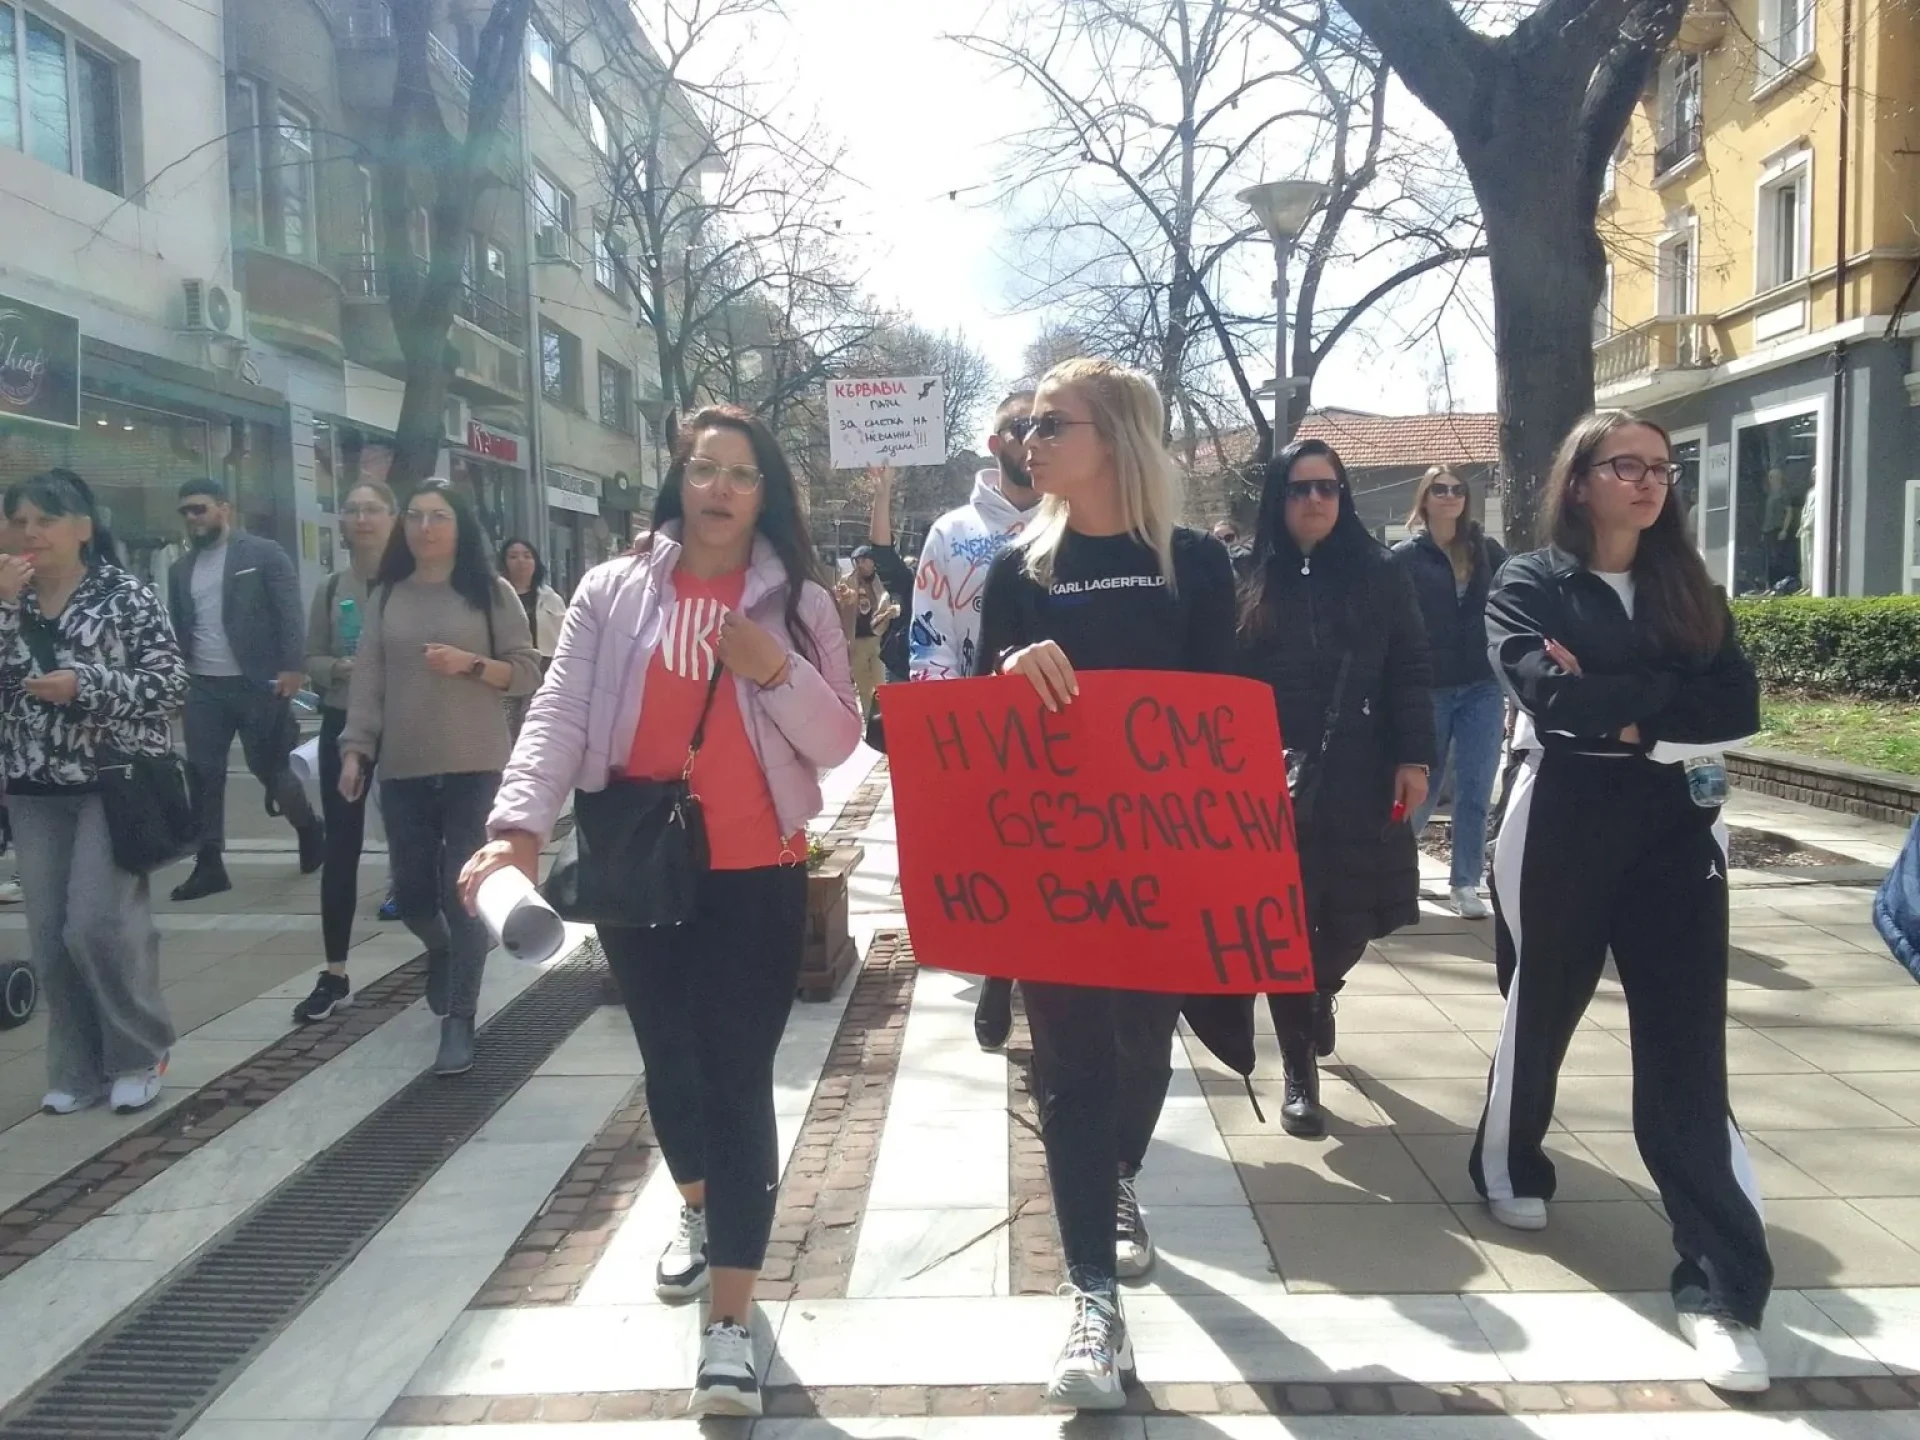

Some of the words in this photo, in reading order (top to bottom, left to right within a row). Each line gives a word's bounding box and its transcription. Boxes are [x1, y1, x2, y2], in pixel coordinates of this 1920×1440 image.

[835, 382, 907, 398] КЪРВАВИ
[913, 416, 928, 426] НА
[1049, 581, 1083, 596] KARL
[1084, 575, 1166, 591] LAGERFELD
[926, 705, 1078, 777] НИЕ
[1124, 696, 1245, 774] СМЕ
[987, 788, 1298, 853] БЕЗГЛАСНИ
[934, 870, 1010, 925] НО
[1037, 871, 1169, 930] ВИЕ
[1201, 884, 1311, 985] НЕ!
